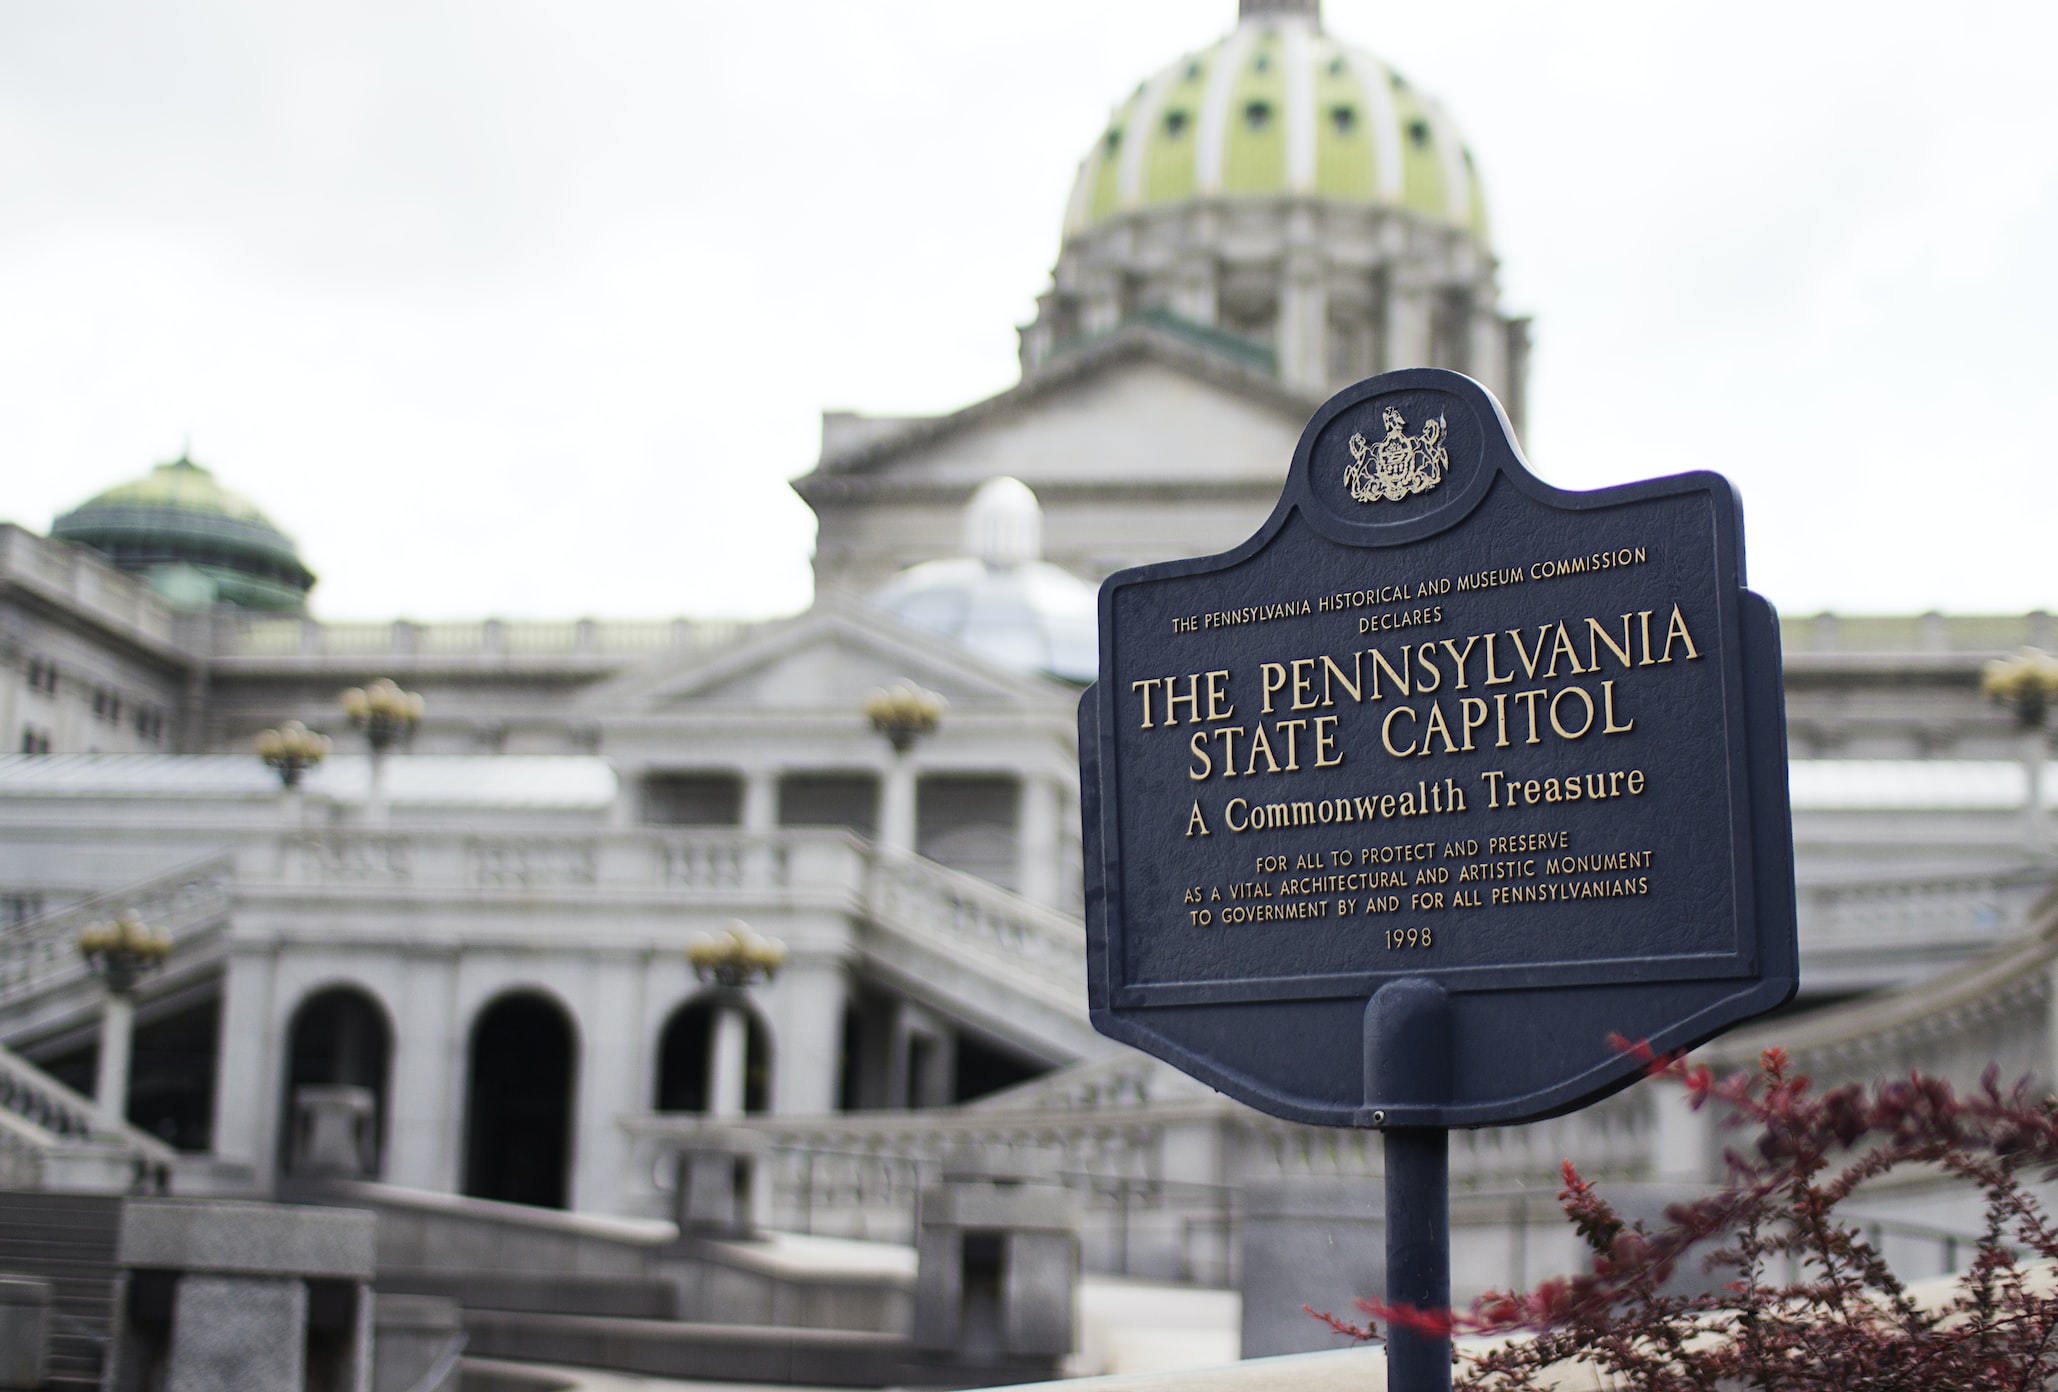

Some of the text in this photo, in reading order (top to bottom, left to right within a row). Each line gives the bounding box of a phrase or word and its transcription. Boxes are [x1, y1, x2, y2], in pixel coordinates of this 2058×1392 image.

[1172, 547, 1646, 632] THE PENNSYLVANIA HISTORICAL AND MUSEUM COMMISSION
[1359, 606, 1442, 634] DECLARES
[1132, 602, 1698, 728] THE PENNSYLVANIA
[1190, 681, 1633, 780] STATE CAPITOL
[1186, 770, 1644, 836] A Commonwealth Treasure
[1183, 850, 1652, 903] AS A VITAL ARCHITECTURAL AND ARTISTIC MONUMENT
[1256, 831, 1568, 872] FOR ALL TO PROTECT AND PRESERVE
[1189, 877, 1648, 925] TO GOVERNMENT BY AND FOR ALL PENNSYLVANIANS
[1386, 928, 1432, 949] 1998
